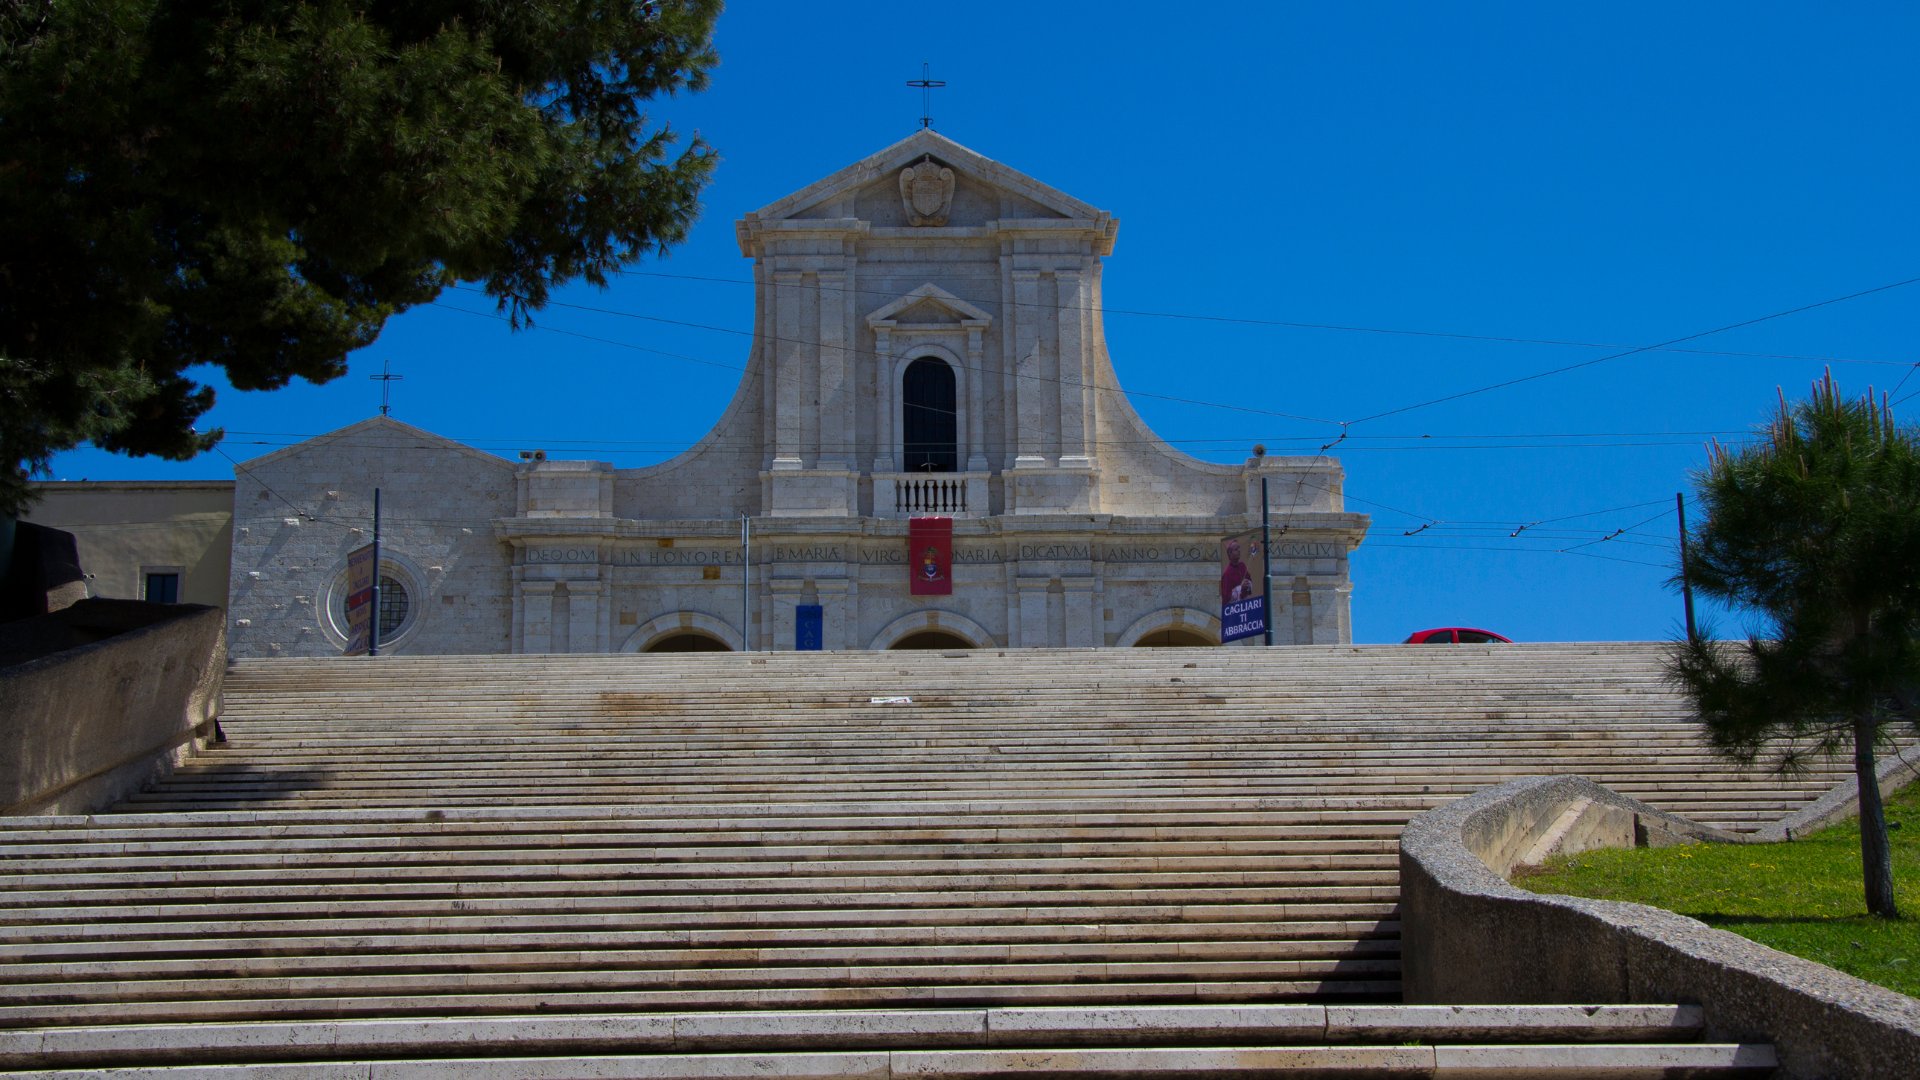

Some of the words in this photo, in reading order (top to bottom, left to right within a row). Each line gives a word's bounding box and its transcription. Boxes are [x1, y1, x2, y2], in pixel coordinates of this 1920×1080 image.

[622, 551, 640, 563] IN
[950, 548, 1001, 561] NARIA
[1108, 547, 1159, 560] ANNO
[1224, 598, 1262, 616] CAGLIARI
[1240, 613, 1248, 623] TI
[1224, 619, 1264, 637] ABBRACCIA
